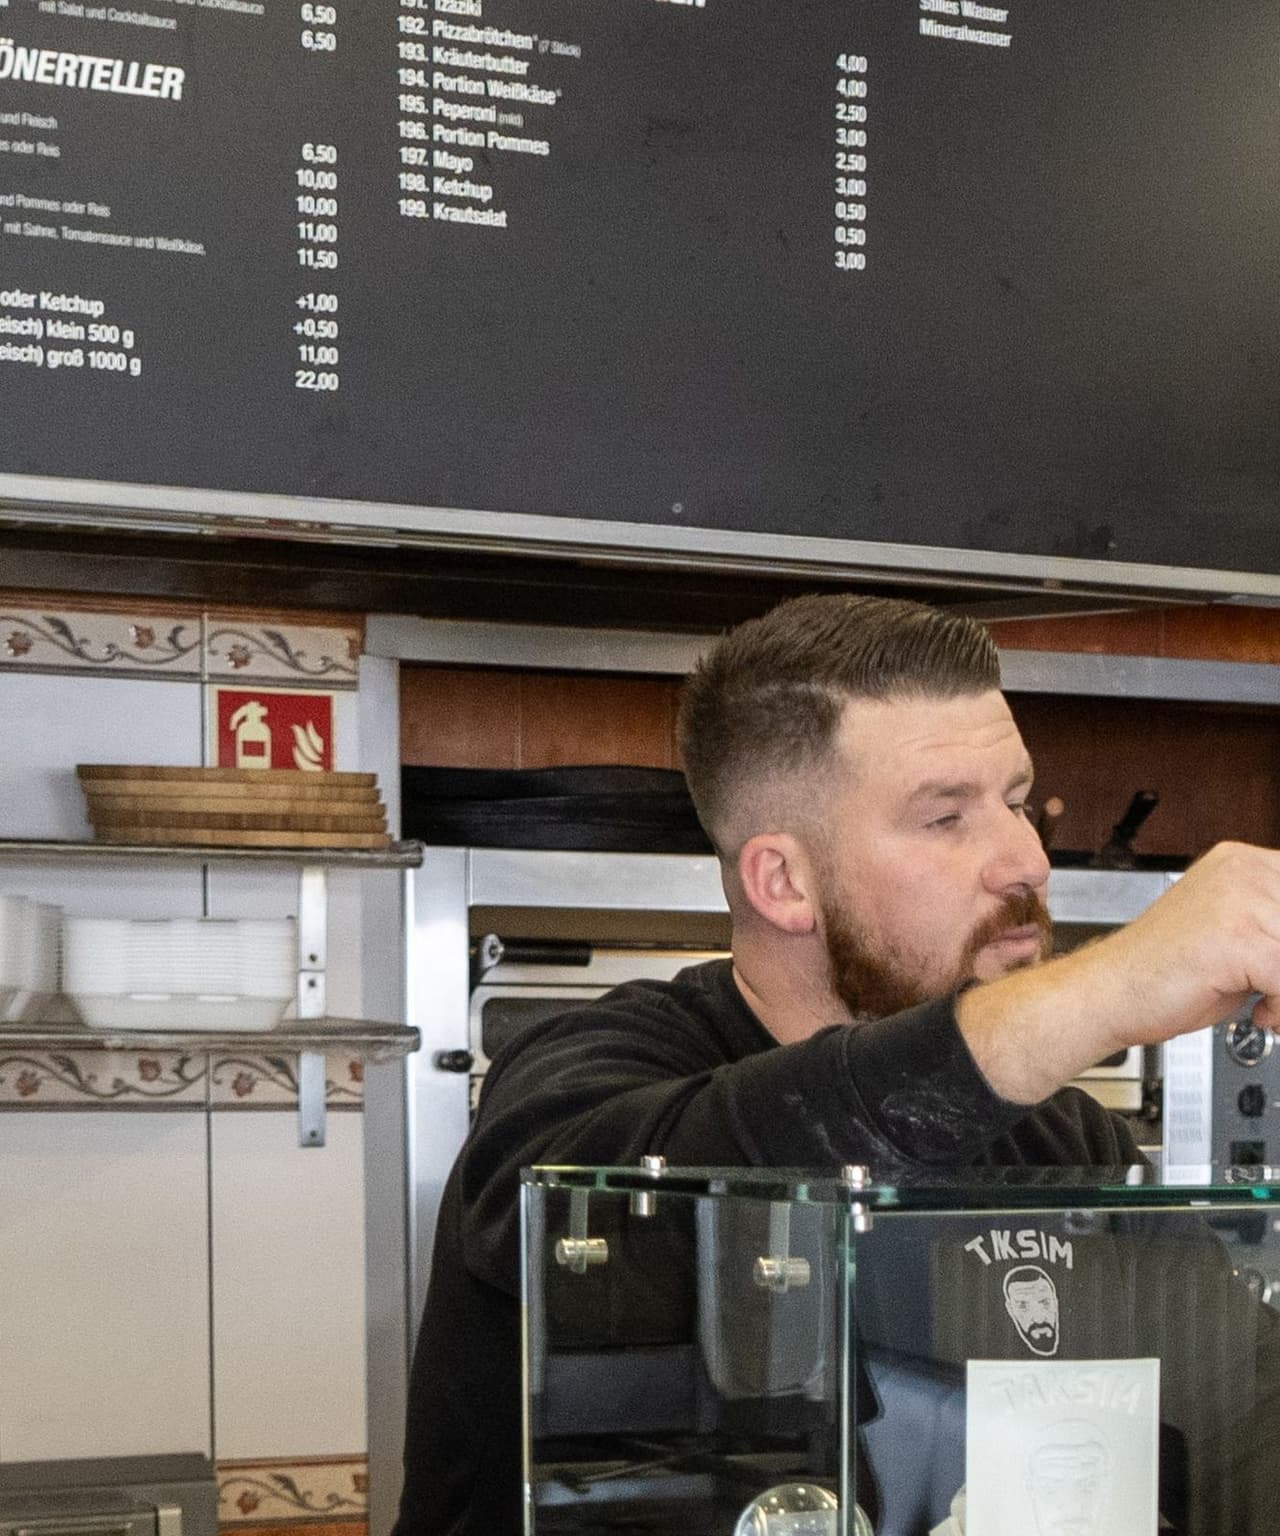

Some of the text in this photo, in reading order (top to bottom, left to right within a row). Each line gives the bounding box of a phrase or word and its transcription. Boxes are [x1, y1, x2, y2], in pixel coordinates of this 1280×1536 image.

[301, 3, 337, 25] 6,50
[397, 15, 429, 36] 192.
[919, 18, 1013, 47] Mineralwasser
[301, 29, 337, 52] 6,50
[397, 42, 529, 75] 193. Kräuterbutter
[836, 53, 868, 74] 4,00
[397, 68, 429, 87] 194.
[433, 71, 485, 95] Portion
[836, 78, 867, 98] 4,00
[397, 94, 429, 114] 195.
[835, 102, 867, 123] 2,50
[397, 120, 549, 156] 196. Portion Pommes
[835, 127, 867, 148] 3,00
[302, 143, 337, 164] 6,50
[398, 147, 474, 174] 197. Mayo
[835, 152, 867, 172] 2,50
[295, 169, 337, 190] 10,00
[397, 172, 493, 203] 198. Ketchup
[835, 176, 867, 197] 3,00
[295, 196, 337, 216] 10,00
[397, 198, 507, 228] 199. Krautsalat
[834, 201, 866, 222] 0,50
[61, 226, 133, 247] Tomatensauce
[297, 222, 338, 243] 11,00
[834, 226, 866, 246] 0,50
[297, 248, 338, 269] 11,50
[834, 250, 866, 271] 3,00
[0, 289, 105, 318] oder Ketchup
[295, 294, 338, 312] +1,00
[46, 319, 85, 340] klein
[88, 323, 120, 344] 500
[122, 330, 134, 349] g
[293, 319, 338, 338] +0,50
[47, 348, 84, 369] groß
[87, 351, 127, 371] 1000
[130, 357, 142, 377] g
[298, 345, 338, 365] 11,00
[295, 370, 339, 391] 22,00
